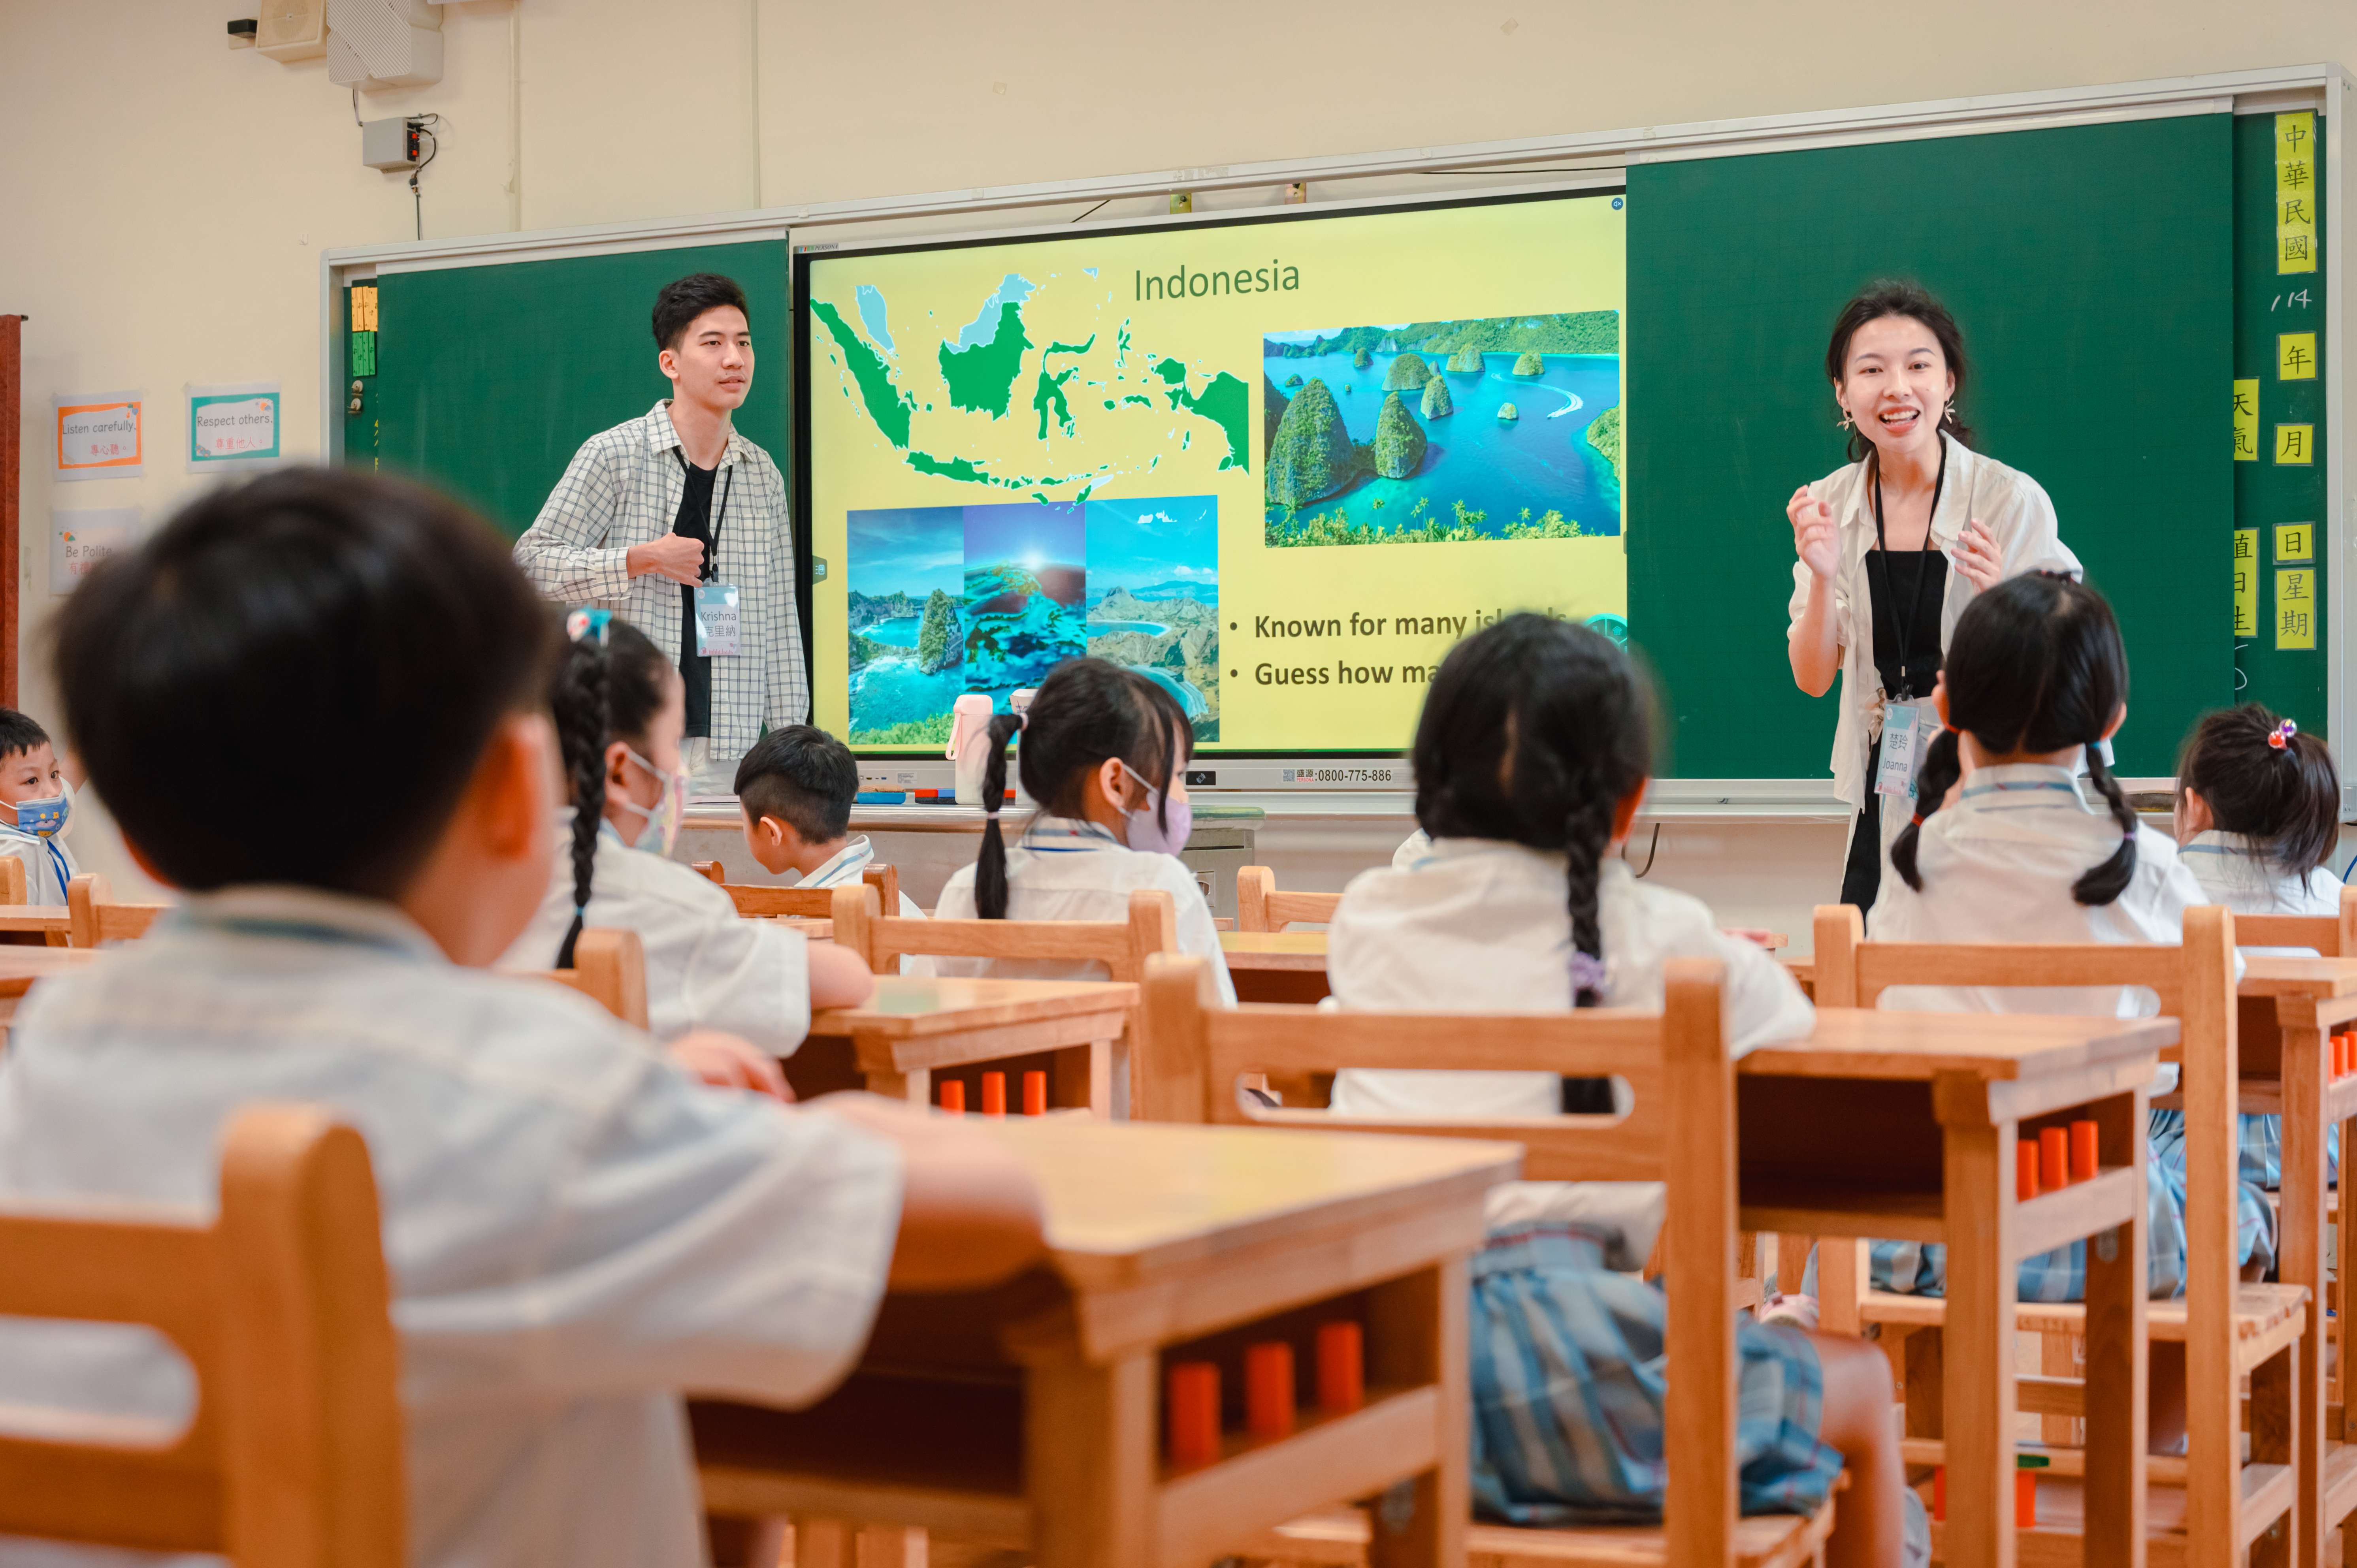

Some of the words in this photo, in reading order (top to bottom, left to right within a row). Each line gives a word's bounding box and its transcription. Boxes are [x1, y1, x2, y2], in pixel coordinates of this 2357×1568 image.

[2284, 124, 2311, 261] 中華民國
[1136, 259, 1299, 301] Indonesia
[2271, 289, 2312, 312] 114
[2283, 345, 2312, 375] 年
[63, 424, 89, 434] Listen
[92, 420, 136, 432] carefully.
[197, 416, 235, 427] Respect
[239, 414, 273, 425] others.
[2281, 431, 2302, 457] 月
[66, 546, 78, 557] Be
[2285, 532, 2301, 553] 日
[701, 611, 736, 621] Krishna
[2280, 574, 2309, 637] 星期
[1255, 616, 1341, 638] Known
[1350, 612, 1387, 636] for
[1396, 616, 1467, 640] many
[1255, 663, 1329, 685] Guess
[1338, 660, 1393, 683] how
[1403, 665, 1441, 683] ma
[1889, 733, 1908, 751] 楚玲
[1882, 757, 1908, 772] Joanna
